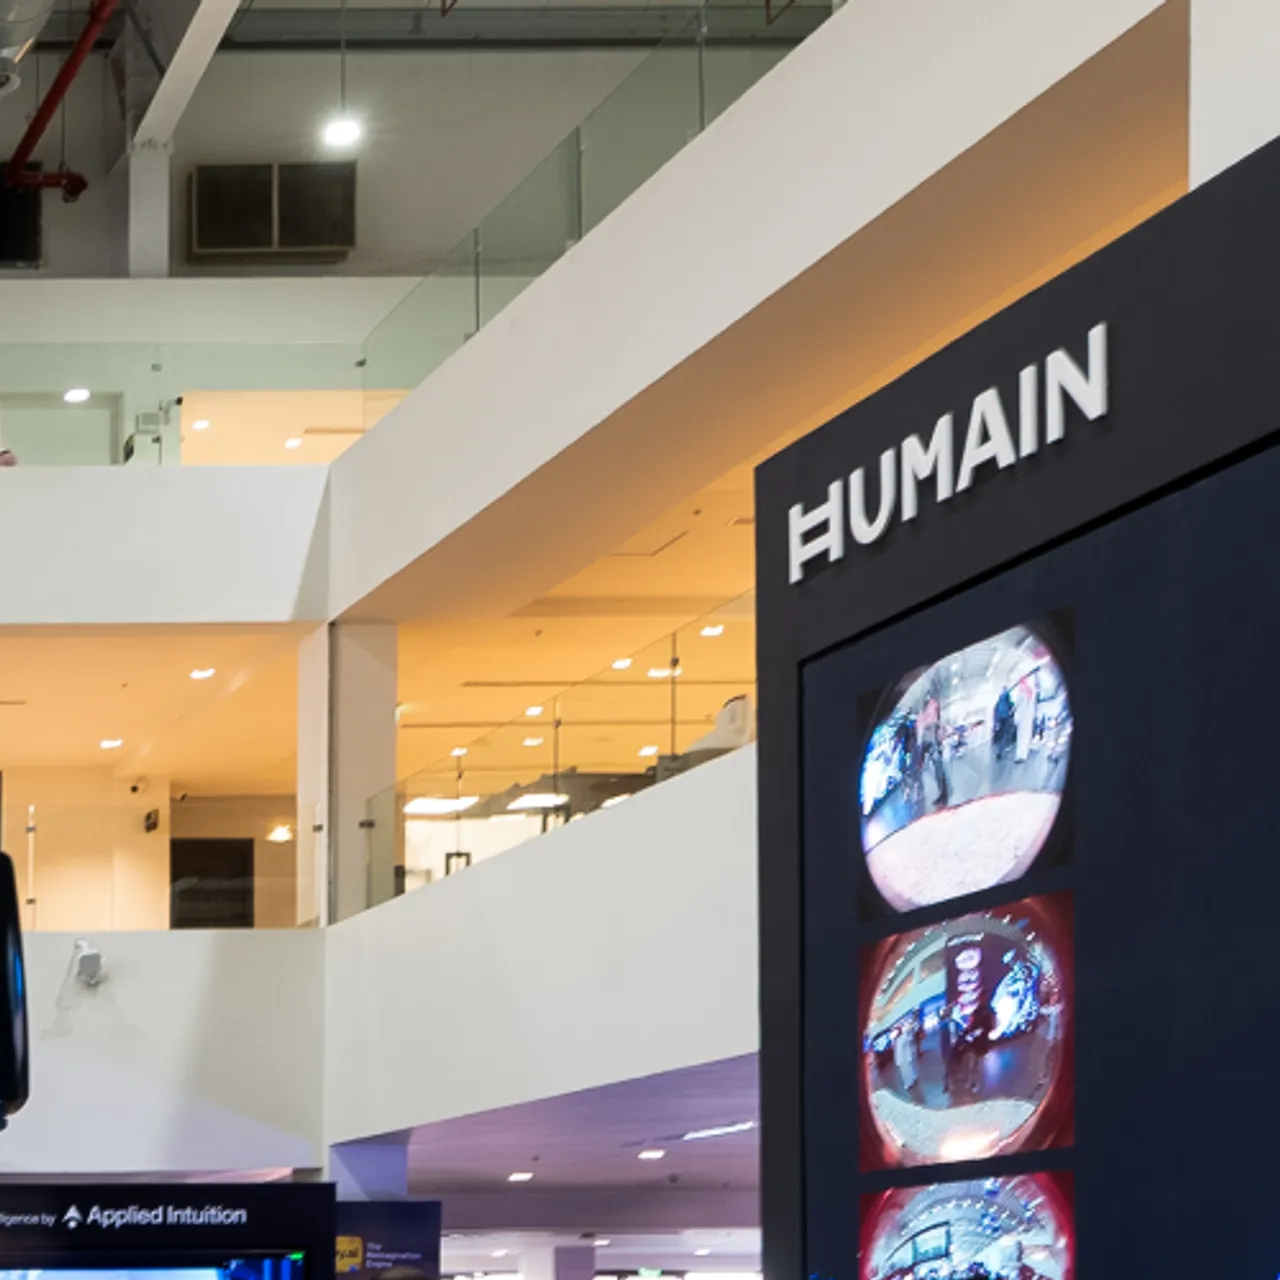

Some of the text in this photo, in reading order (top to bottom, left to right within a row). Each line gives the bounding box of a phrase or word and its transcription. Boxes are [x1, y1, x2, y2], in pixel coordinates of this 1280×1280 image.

[788, 321, 1109, 585] HUMAIN
[87, 1205, 164, 1229] Applied
[167, 1205, 247, 1225] Intuition
